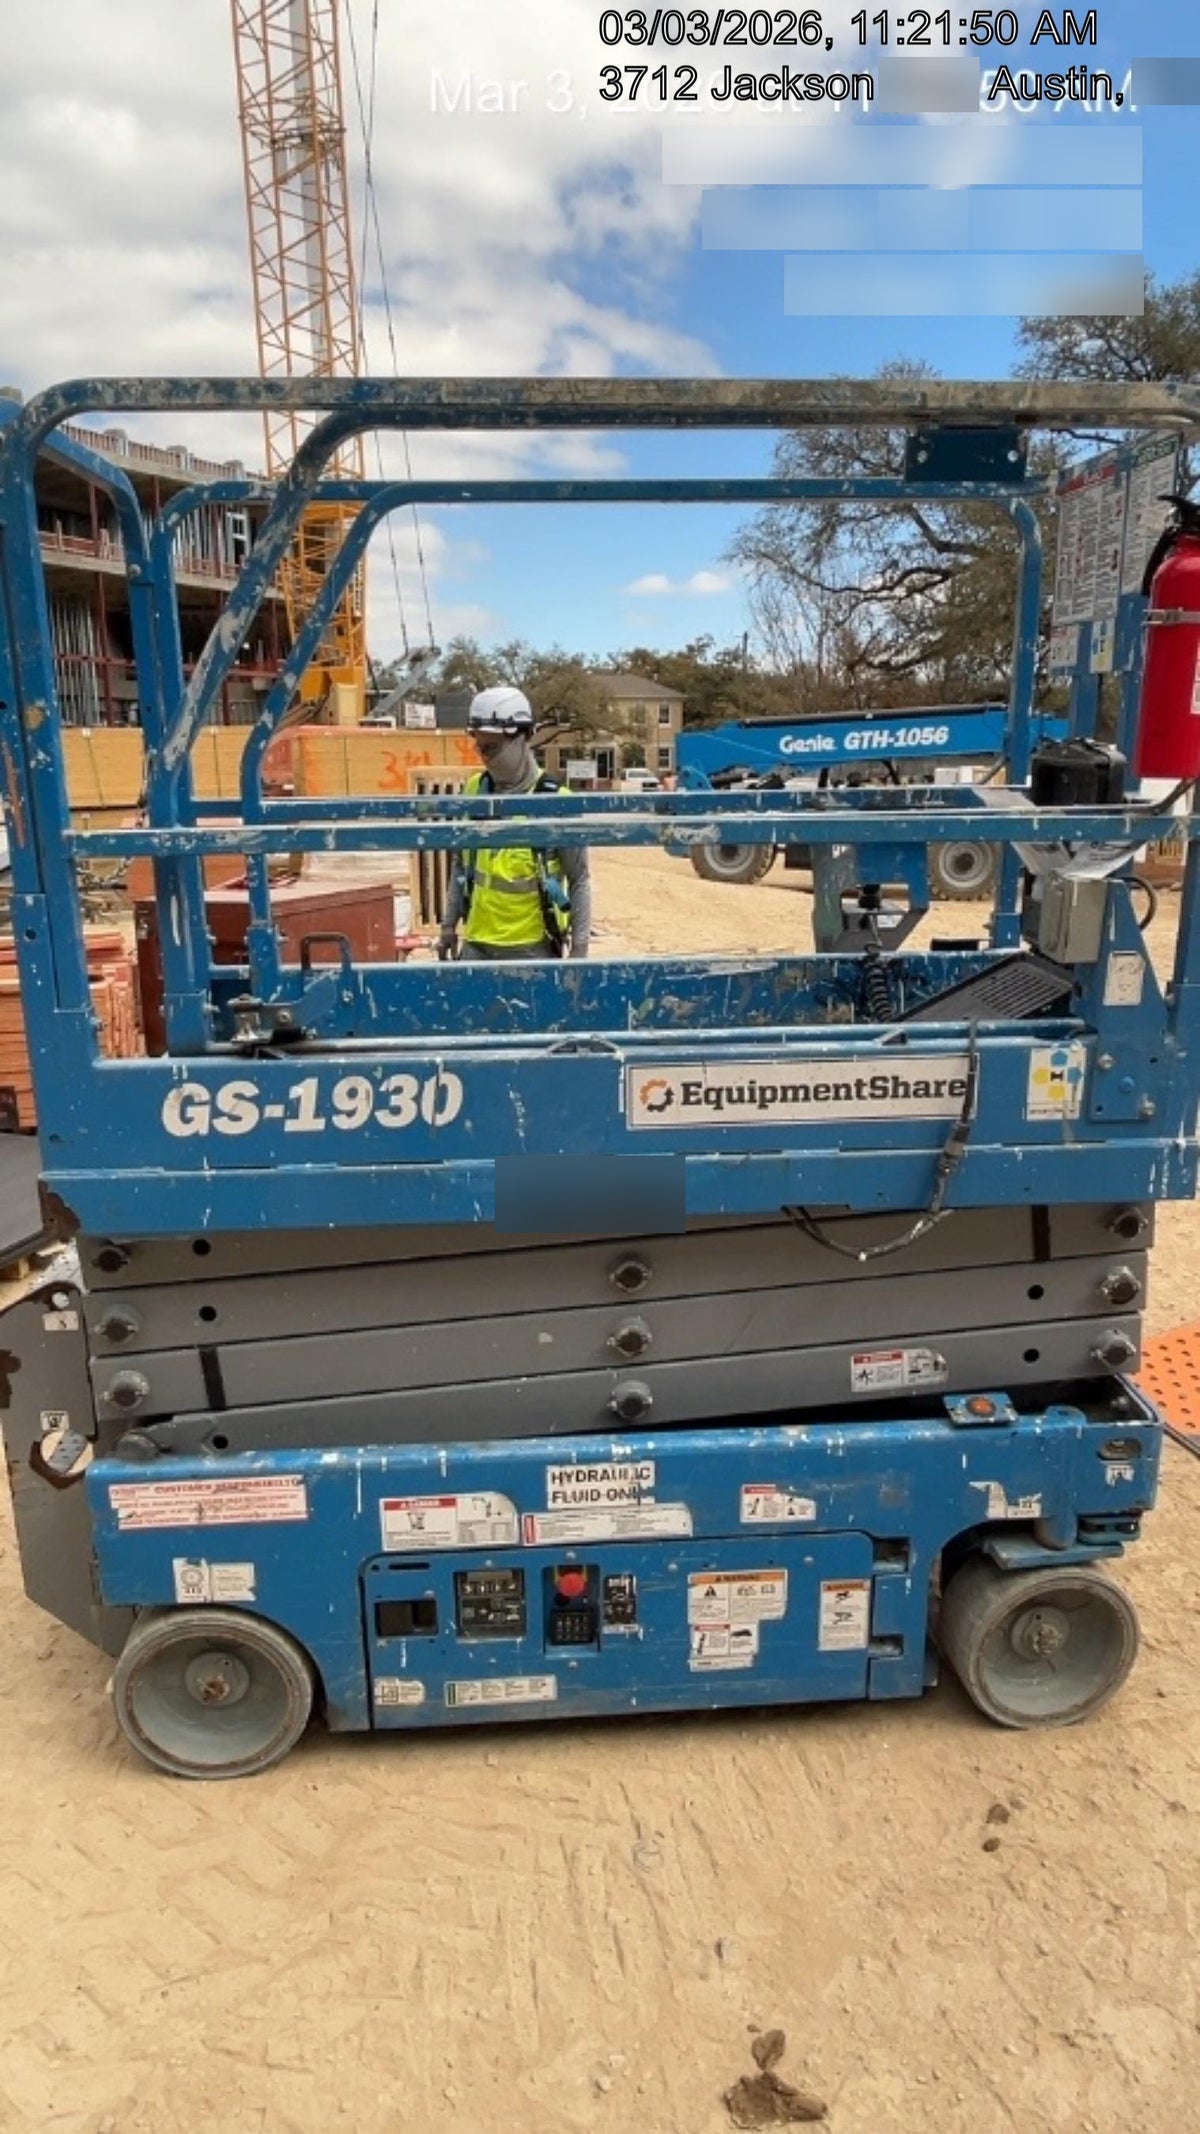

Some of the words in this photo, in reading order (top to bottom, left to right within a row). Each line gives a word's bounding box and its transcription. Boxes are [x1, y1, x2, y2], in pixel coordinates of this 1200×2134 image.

[780, 734, 837, 755] Genie
[844, 726, 949, 751] GTH-1056
[162, 1072, 463, 1137] GS-1930
[680, 1075, 967, 1110] EquipmentShare
[552, 1488, 600, 1504] FLUID
